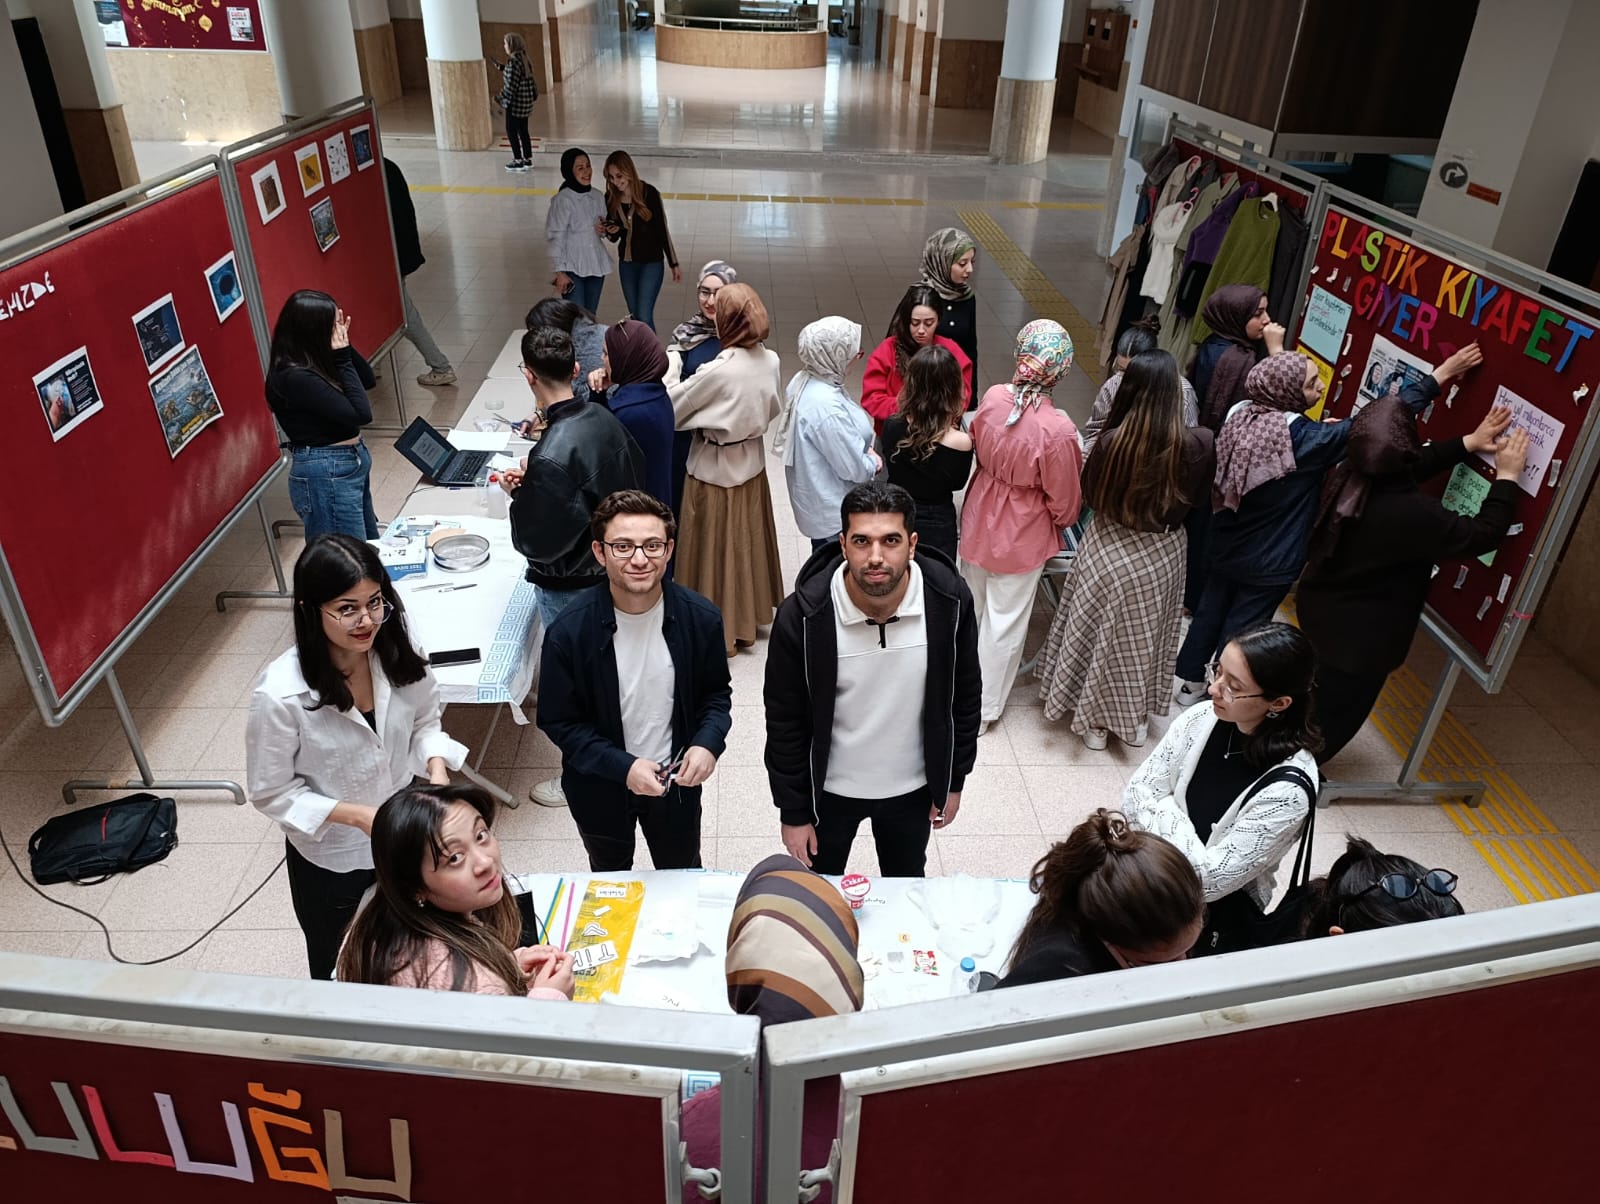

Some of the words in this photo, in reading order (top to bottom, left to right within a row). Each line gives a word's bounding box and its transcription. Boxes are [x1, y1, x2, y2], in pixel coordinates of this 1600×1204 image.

[1321, 211, 1429, 296] PLASTİK
[1435, 264, 1595, 373] KIYAFET
[0, 1076, 411, 1202] ULUĞU
